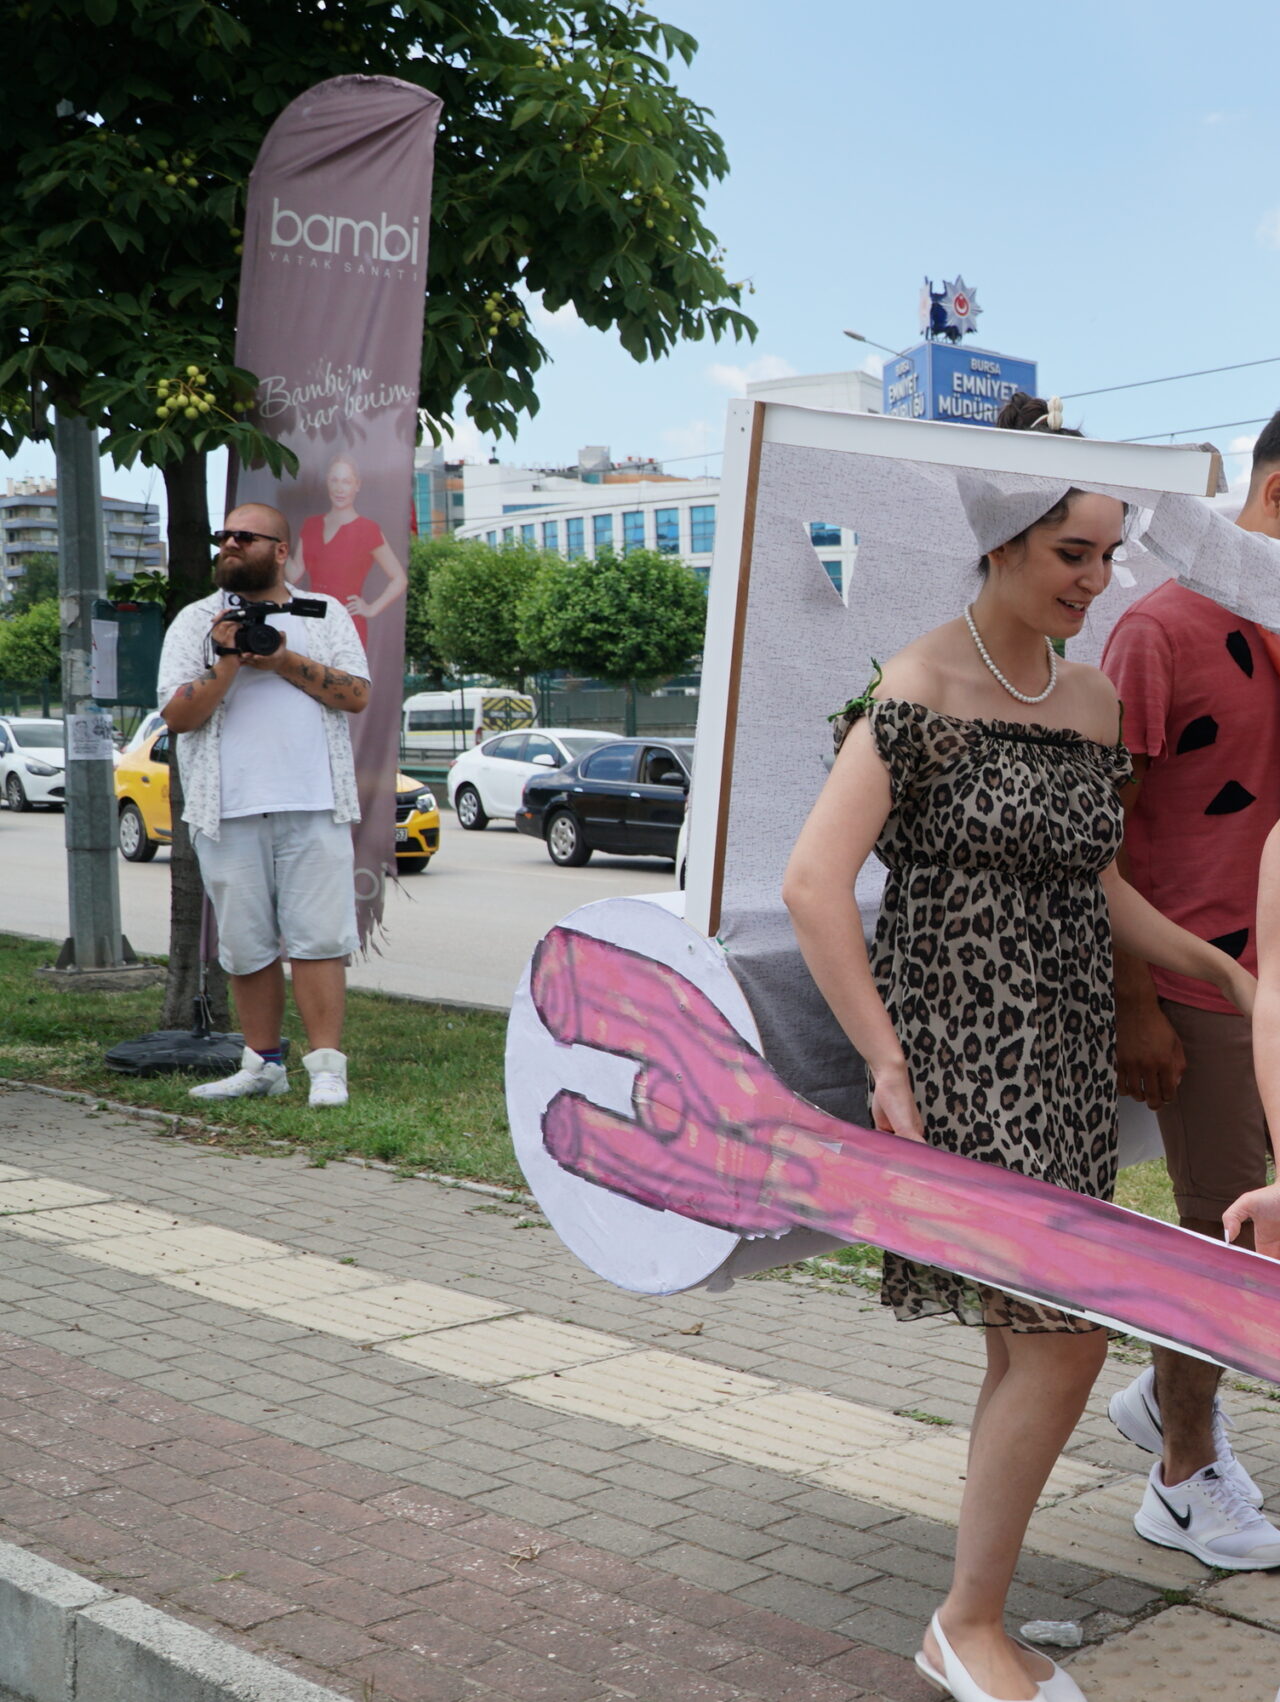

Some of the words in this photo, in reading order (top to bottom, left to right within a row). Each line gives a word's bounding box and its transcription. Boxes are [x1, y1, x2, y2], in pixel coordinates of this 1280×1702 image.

[270, 197, 420, 265] bambi
[270, 252, 332, 270] YATAK
[343, 261, 418, 282] SANATI
[971, 357, 1002, 376] BURSA
[258, 361, 373, 418] Bambi'm
[952, 371, 1019, 401] EMNİYET
[299, 403, 340, 433] var
